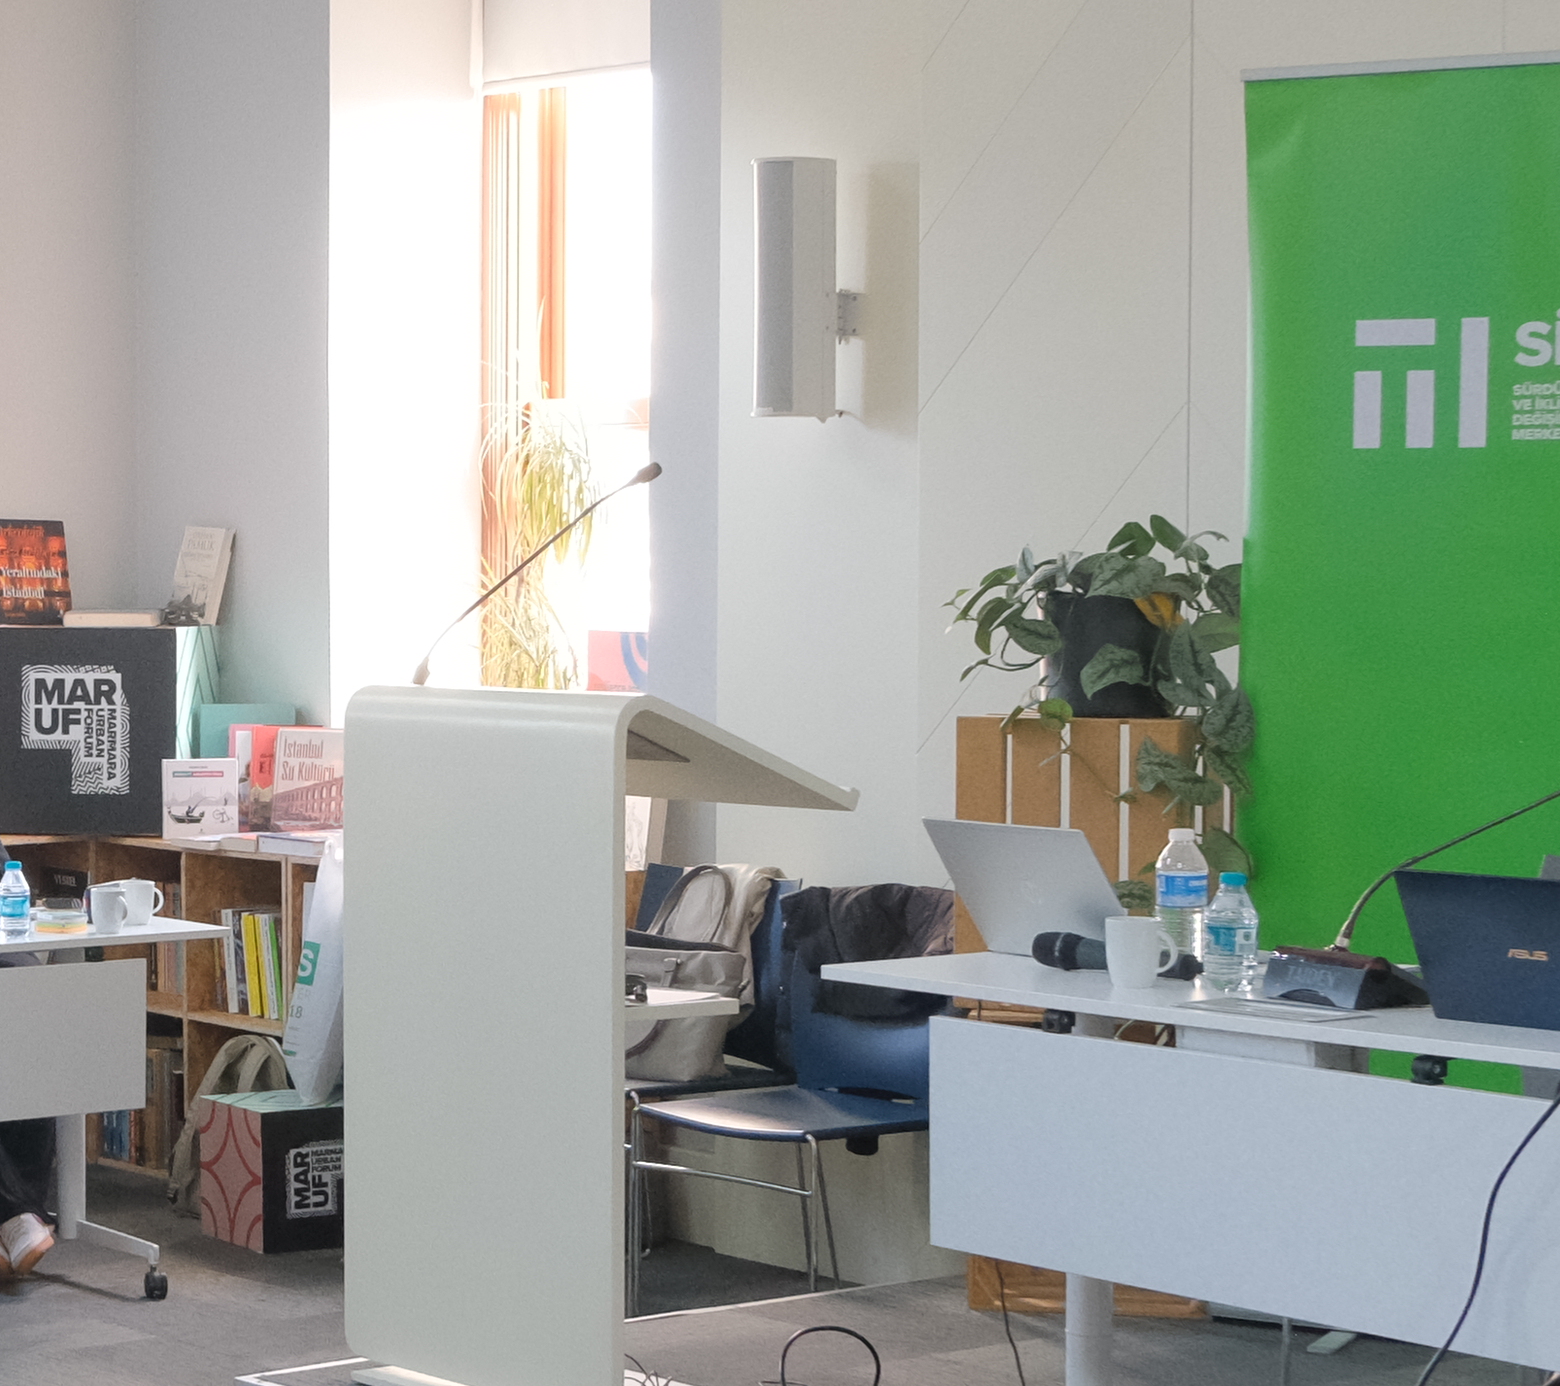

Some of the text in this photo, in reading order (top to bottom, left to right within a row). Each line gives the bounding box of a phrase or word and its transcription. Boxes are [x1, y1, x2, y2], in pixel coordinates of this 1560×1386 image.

[1511, 398, 1532, 411] VE
[34, 678, 117, 706] MAR
[34, 707, 82, 736] UF
[84, 708, 94, 758] FORUM
[95, 708, 105, 758] URBAN
[107, 708, 117, 781] MARMARA
[283, 736, 324, 759] İstanbul
[281, 760, 295, 781] Su
[1507, 948, 1549, 961] ASUS
[293, 1151, 311, 1210] MAR
[311, 1174, 330, 1208] UF
